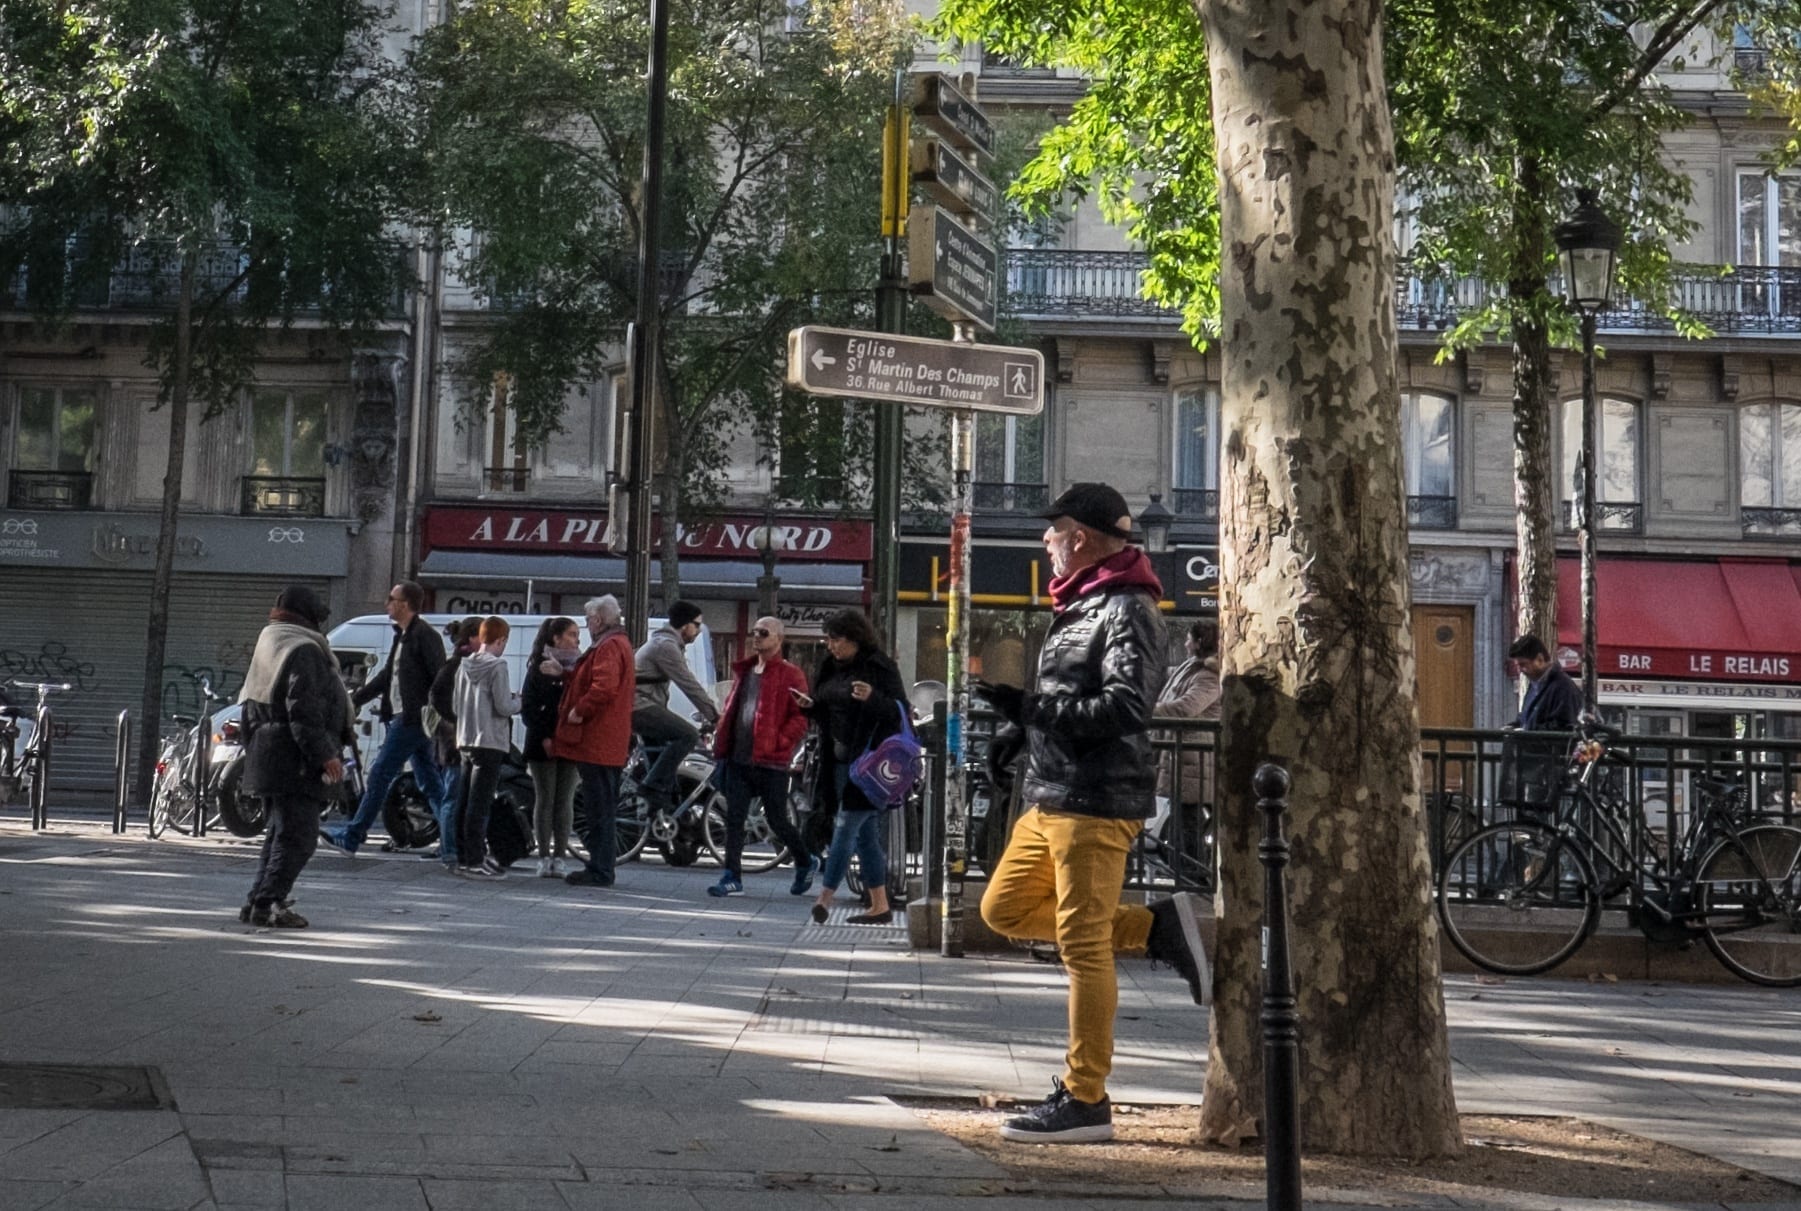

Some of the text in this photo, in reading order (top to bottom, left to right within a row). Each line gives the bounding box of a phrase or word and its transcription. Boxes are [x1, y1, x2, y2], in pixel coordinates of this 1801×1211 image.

[846, 338, 896, 359] Eglise
[868, 360, 913, 379] Martin
[917, 364, 942, 382] Des
[946, 369, 1000, 389] Champs
[868, 379, 891, 392] Rue
[896, 381, 933, 396] Albert
[939, 385, 984, 402] Thomas
[470, 516, 494, 541] A
[504, 517, 551, 543] LA
[1619, 654, 1790, 676] BAR LE RELAIS
[1602, 684, 1644, 694] BAR
[1661, 684, 1689, 695] LE
[1696, 686, 1777, 698] RELAIS
